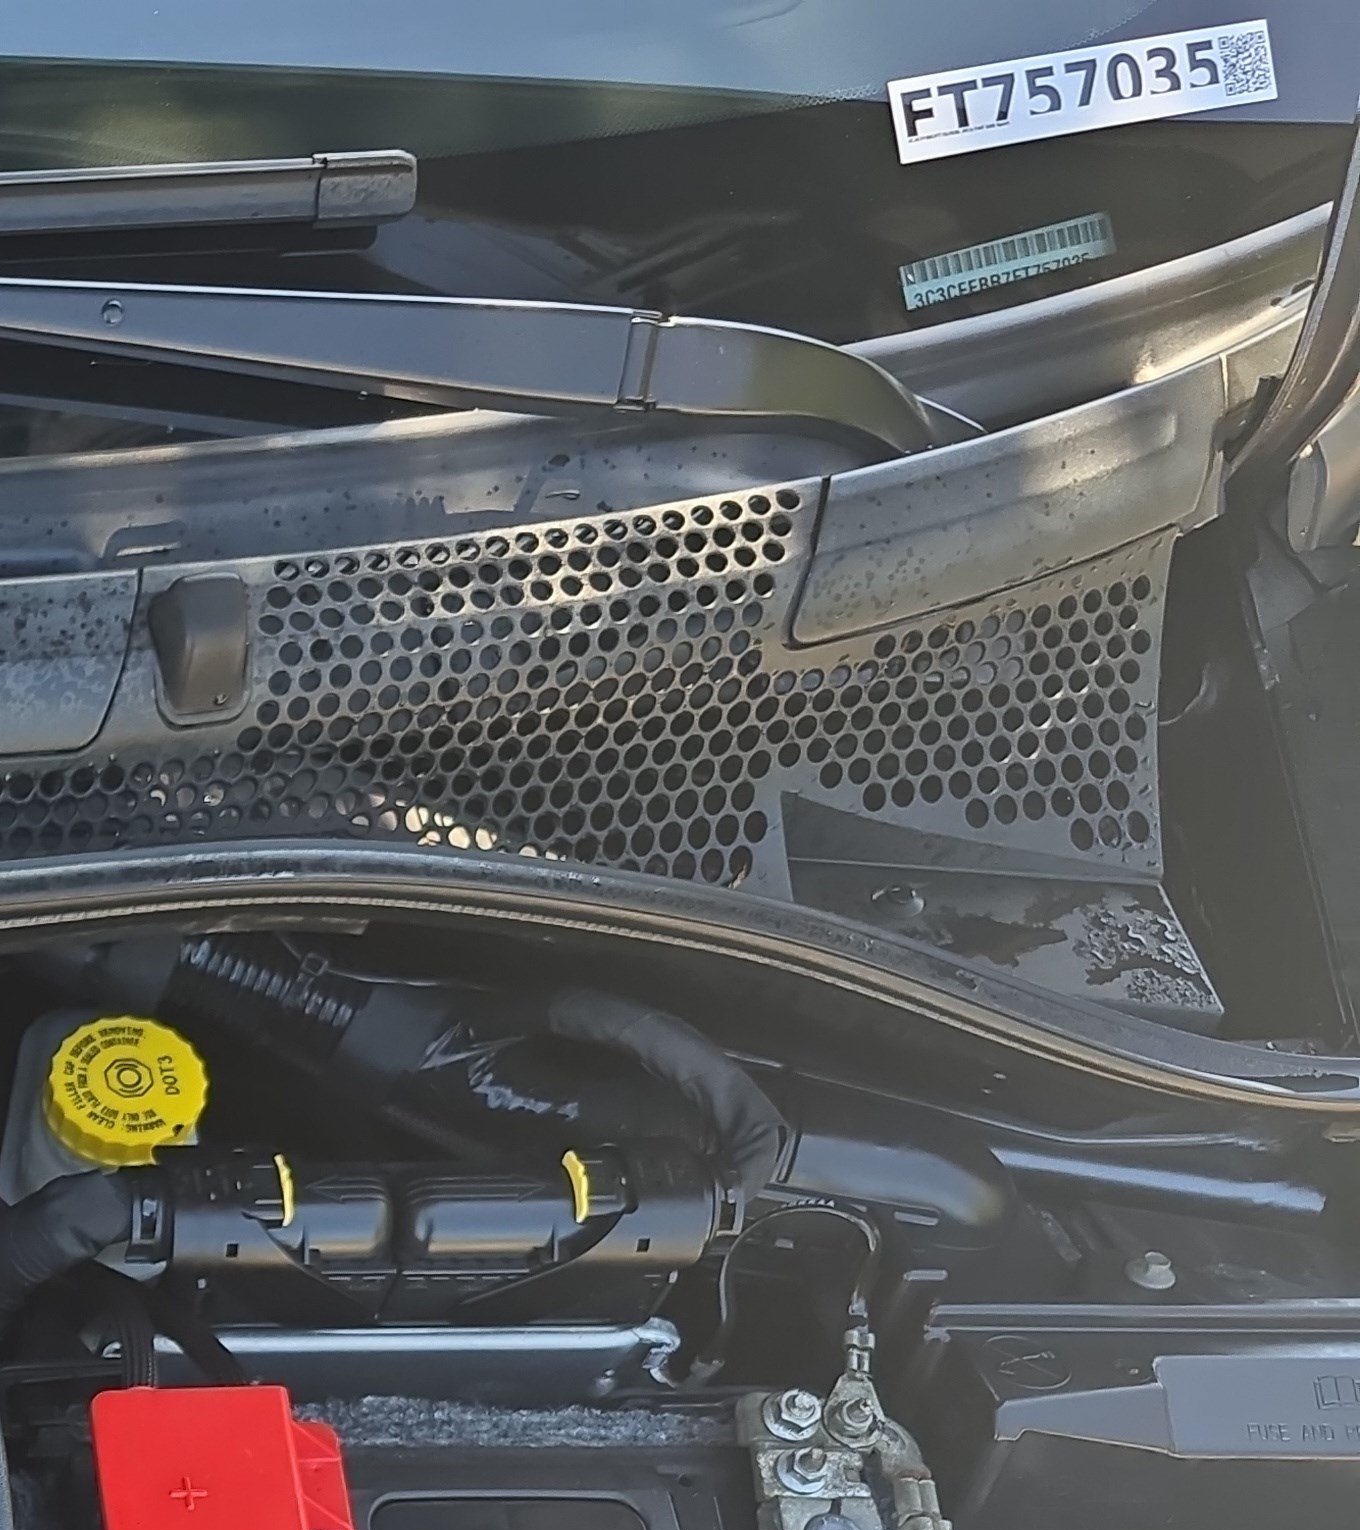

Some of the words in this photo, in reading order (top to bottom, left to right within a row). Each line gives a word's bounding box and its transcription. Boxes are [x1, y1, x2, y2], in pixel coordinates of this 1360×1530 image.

[900, 39, 1221, 137] FT757035
[65, 1082, 86, 1110] FILLER
[87, 1111, 115, 1129] CLEAN
